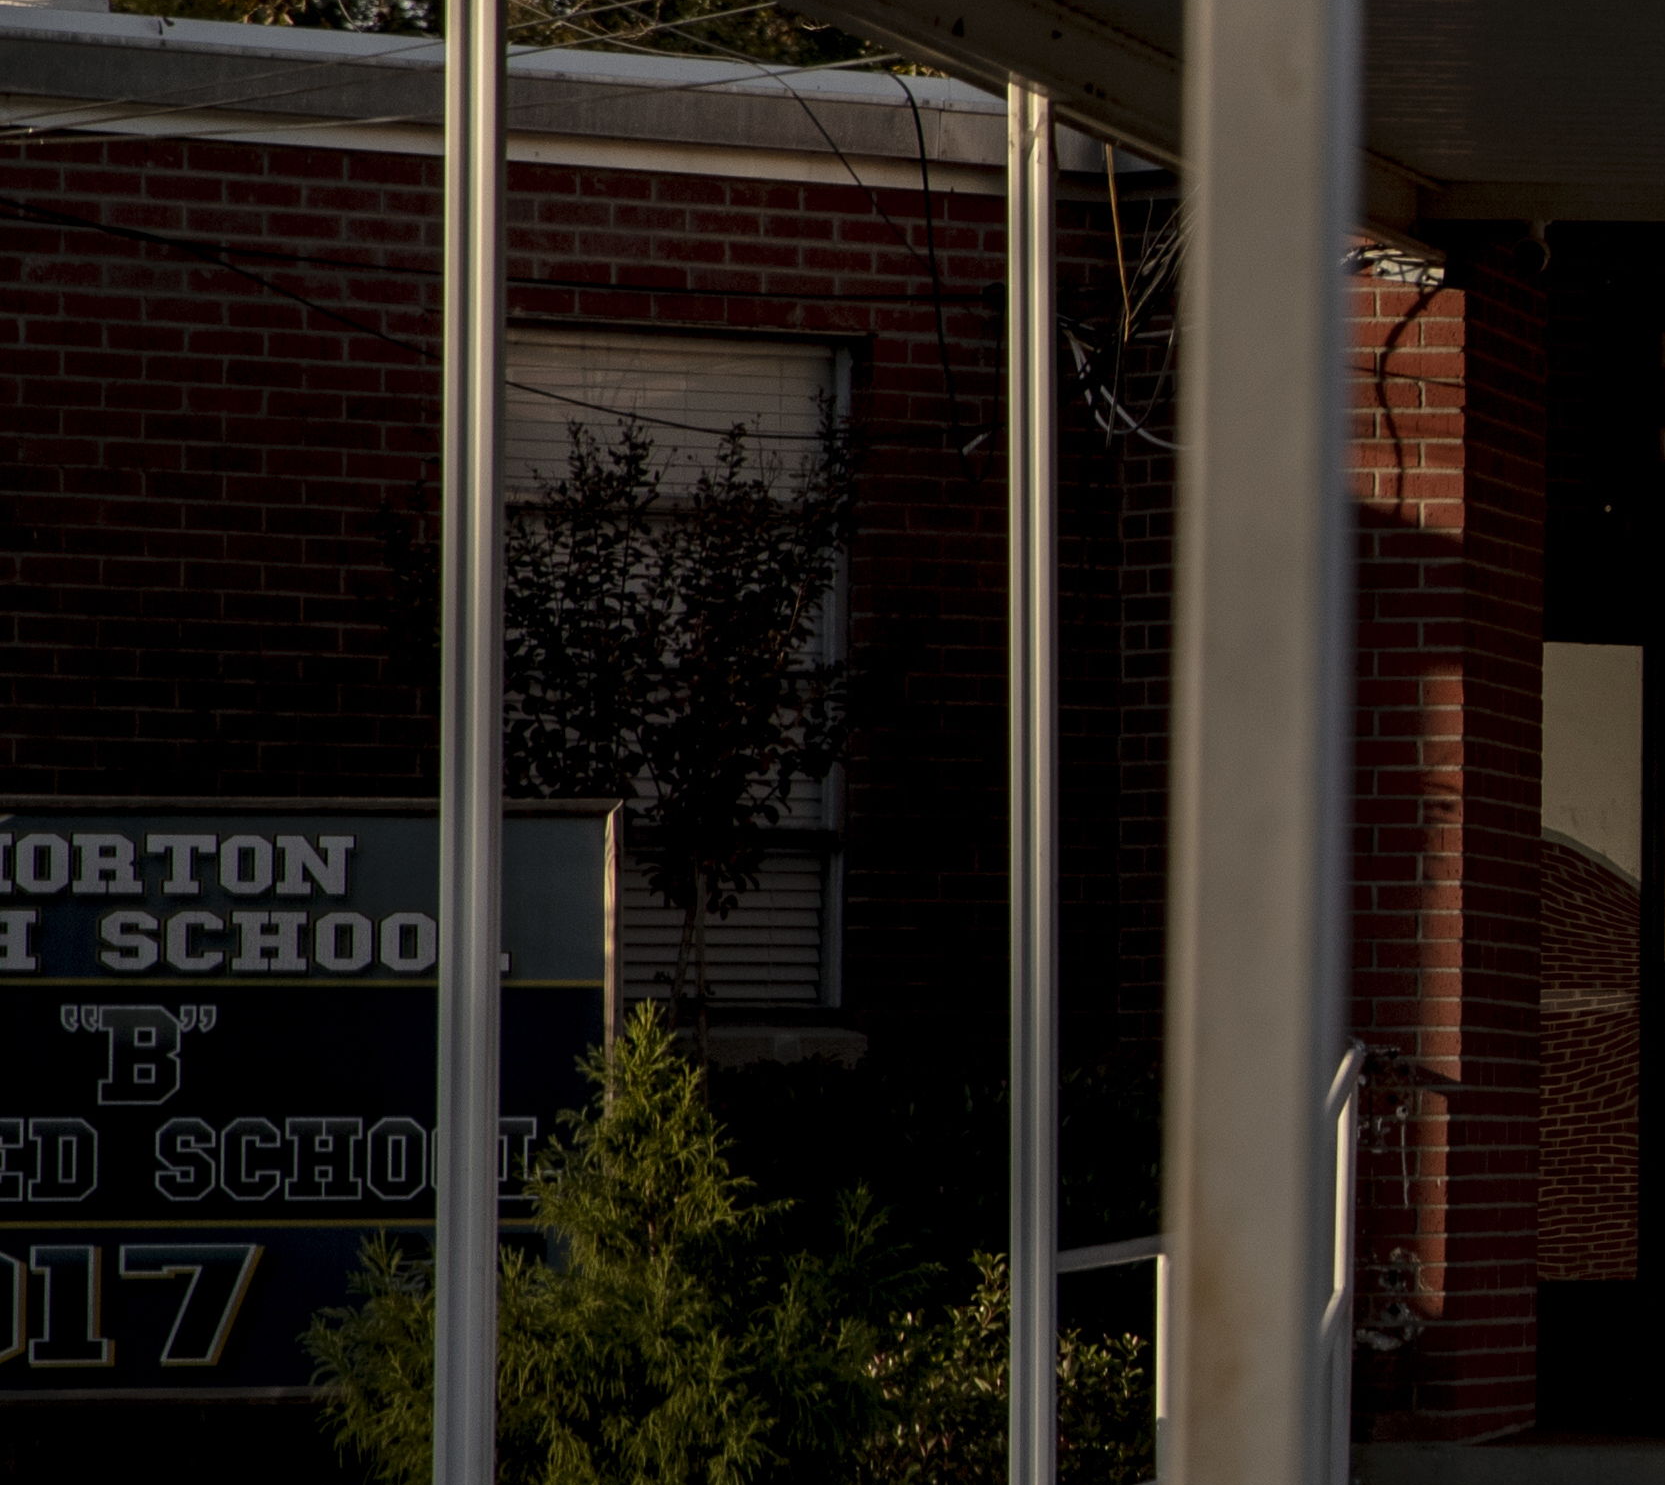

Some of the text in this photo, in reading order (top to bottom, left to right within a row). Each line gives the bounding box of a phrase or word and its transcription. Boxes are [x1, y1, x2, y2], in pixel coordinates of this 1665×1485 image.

[0, 833, 356, 896] ORTON
[100, 911, 511, 972] SCHOO
[155, 1118, 562, 1201] SCHOL
[0, 1244, 264, 1367] 17
